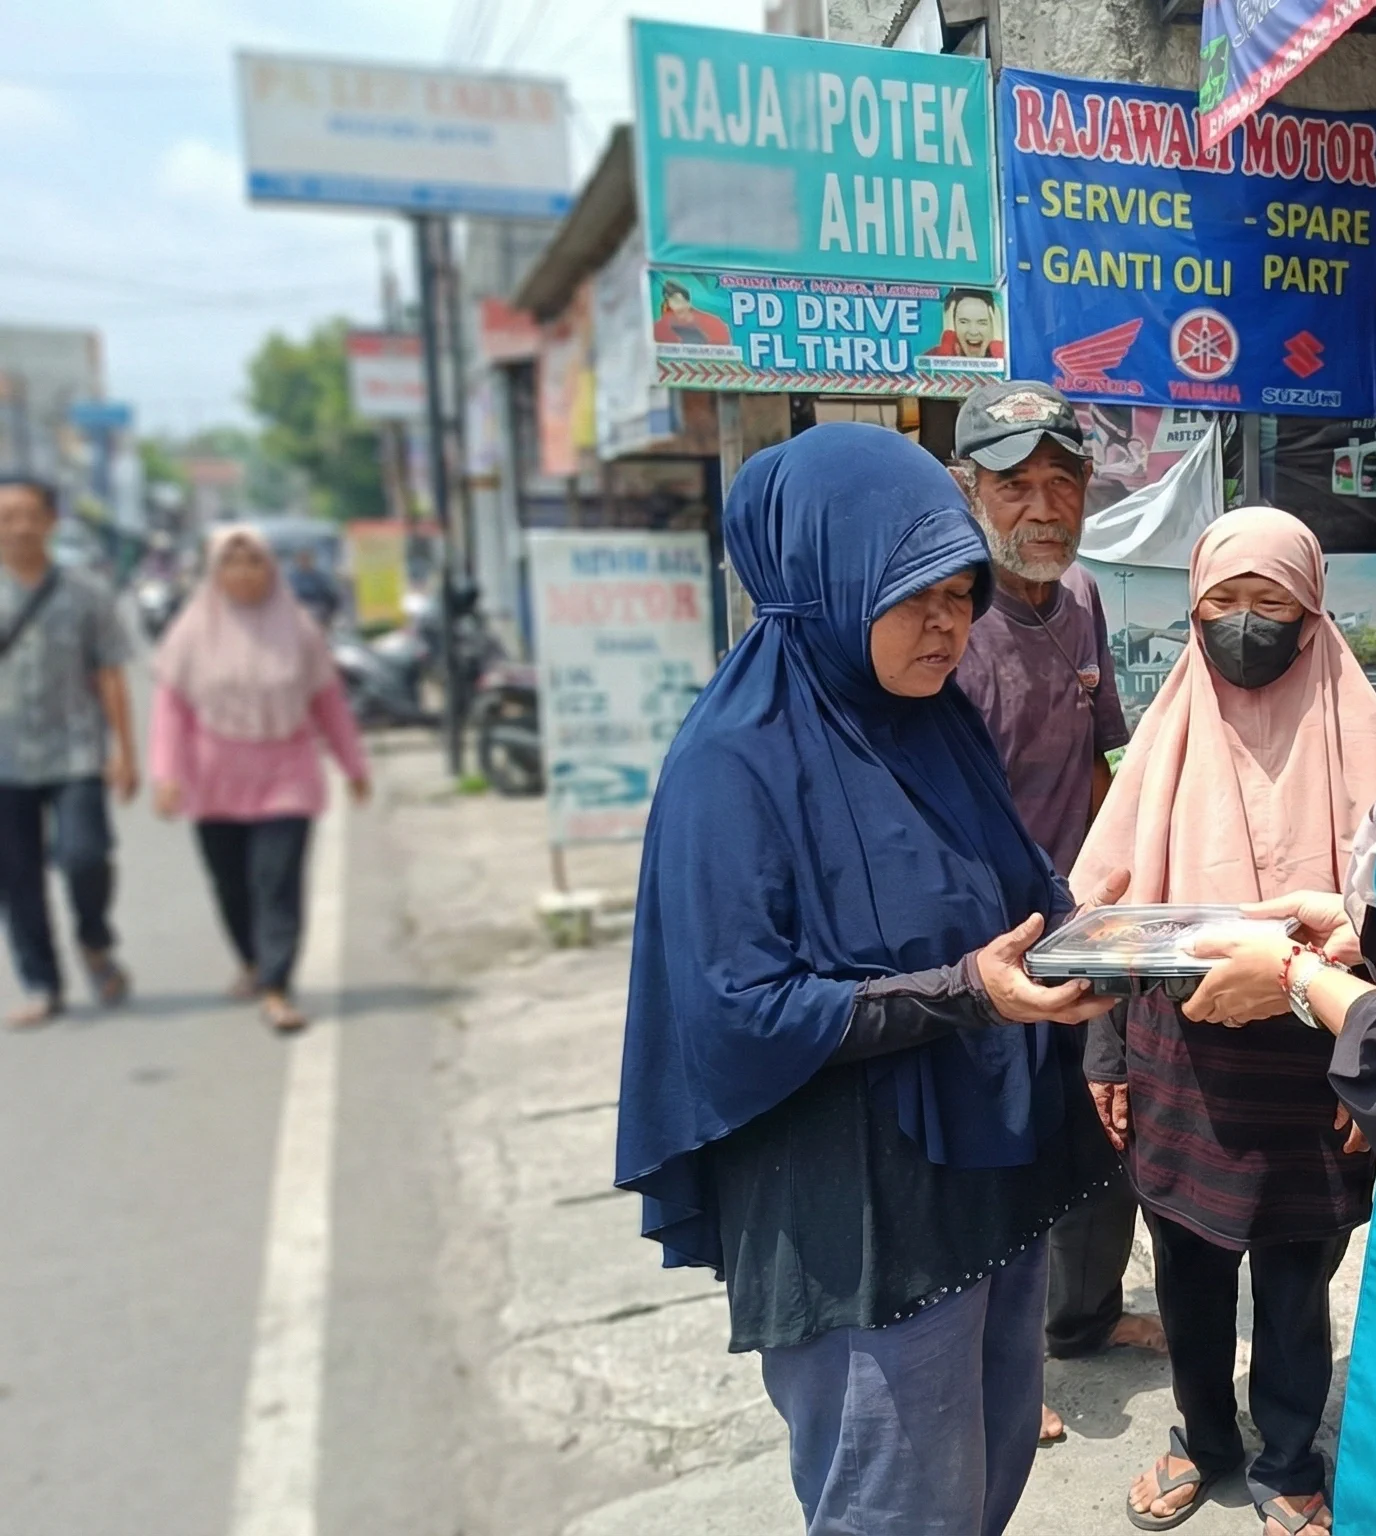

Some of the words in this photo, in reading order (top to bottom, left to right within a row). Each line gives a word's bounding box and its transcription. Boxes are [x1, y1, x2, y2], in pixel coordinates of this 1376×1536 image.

[818, 72, 974, 168] POTEK
[819, 173, 978, 261] AHIRA
[1041, 179, 1194, 231] SERVICE
[1266, 202, 1371, 246] SPARE
[1042, 246, 1162, 292] GANTI
[1173, 256, 1232, 297] OLI
[1264, 254, 1351, 296] PART
[731, 291, 784, 327] PD
[797, 295, 921, 334] DRIVE
[1262, 387, 1342, 407] SUZUKI
